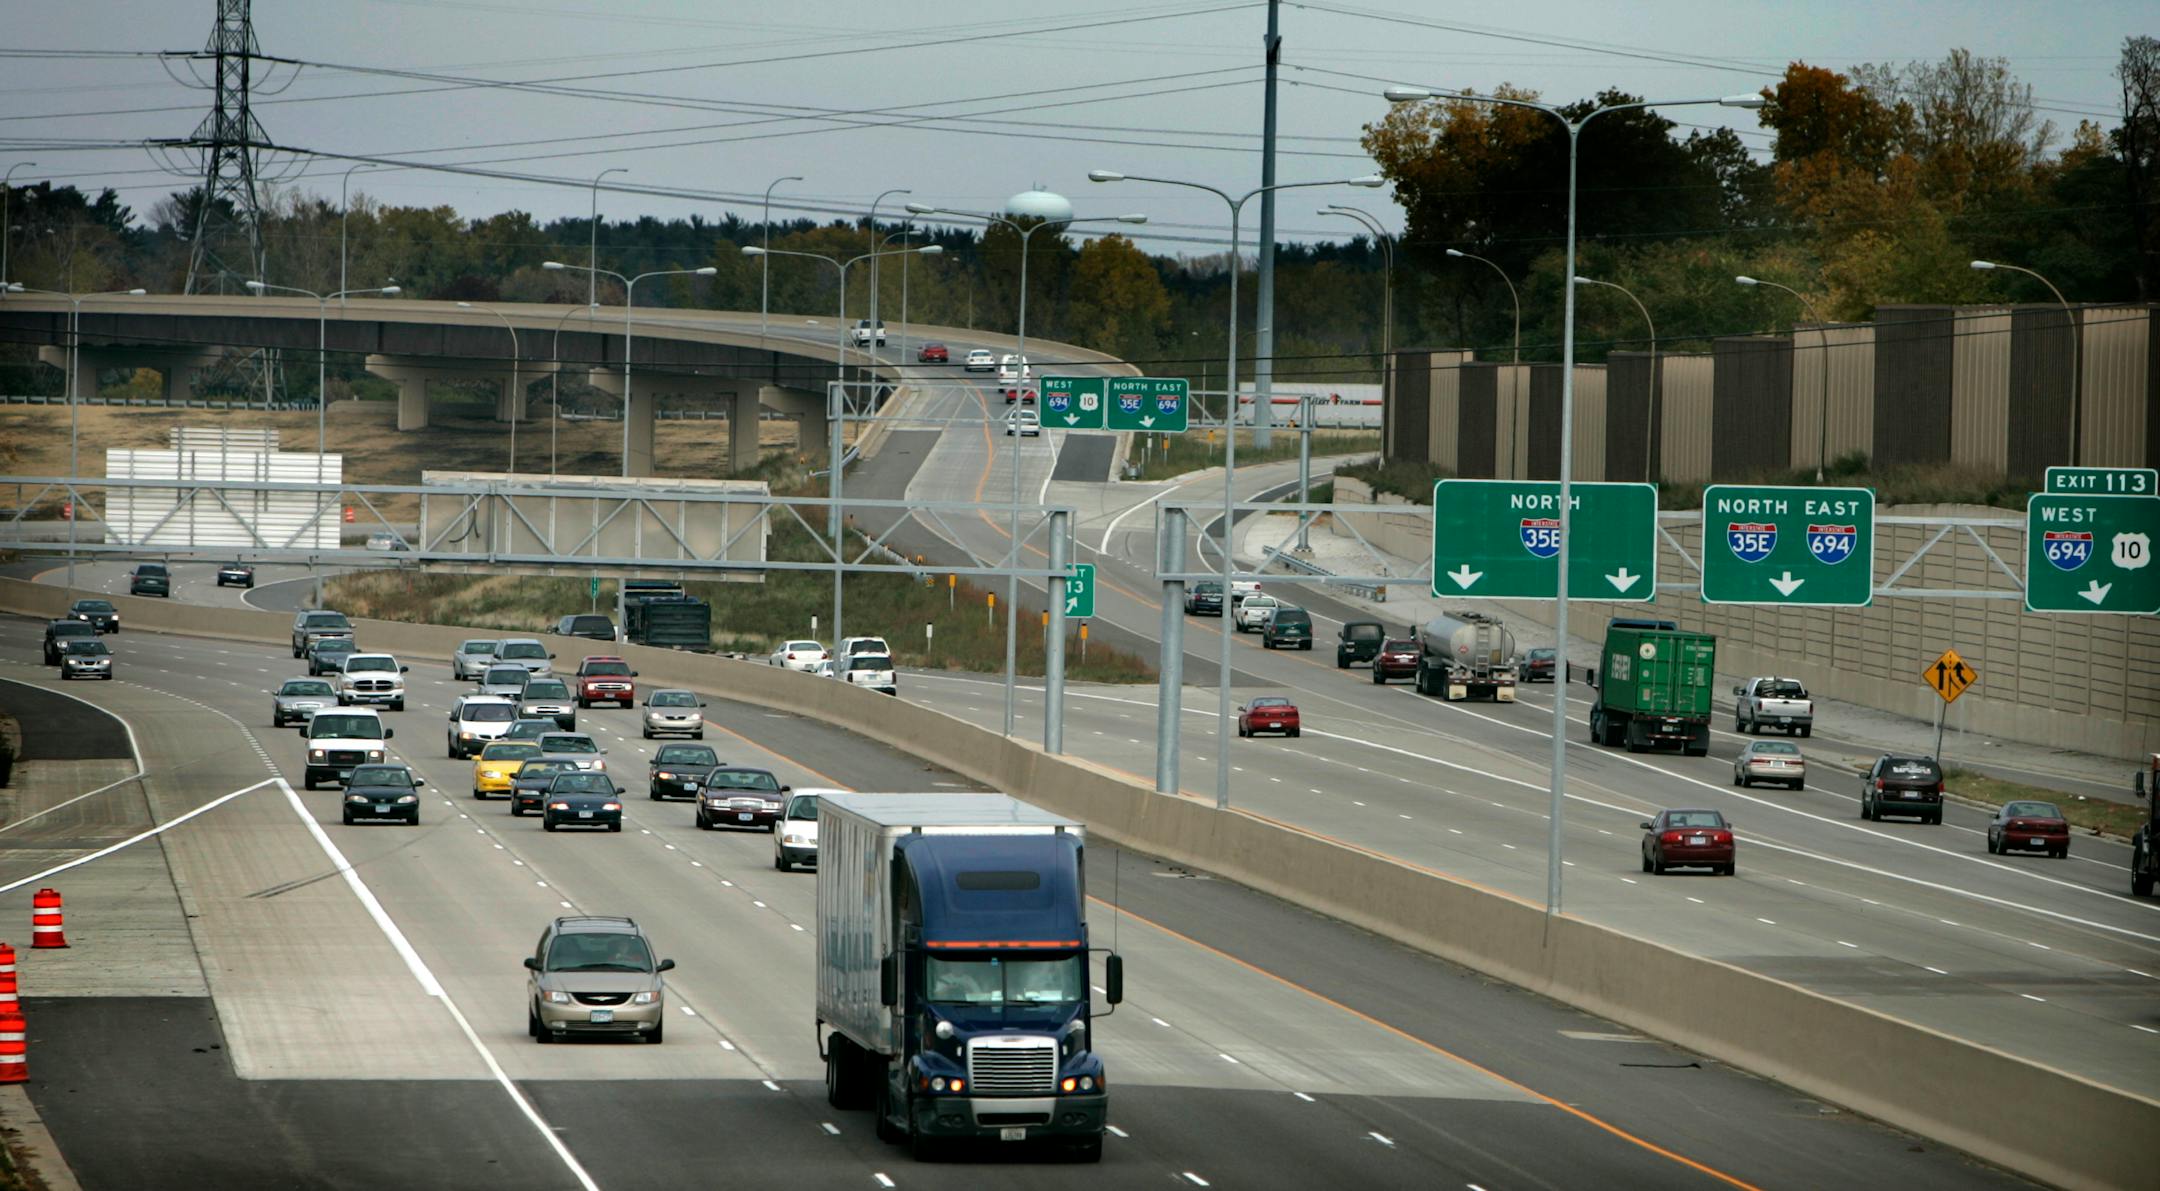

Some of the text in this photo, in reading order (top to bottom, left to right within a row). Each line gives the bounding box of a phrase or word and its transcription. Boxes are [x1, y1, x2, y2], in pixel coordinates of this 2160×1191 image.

[1045, 380, 1073, 389] WEST
[1113, 382, 1182, 392] NORTH EAST
[1049, 397, 1068, 407] 694
[1083, 397, 1094, 406] 10
[1120, 399, 1139, 409] 35E
[1158, 400, 1177, 410] 694
[2056, 473, 2146, 492] EXIT 113
[1511, 494, 1580, 510] NORTH
[1718, 498, 1859, 516] NORTH EAST
[2041, 506, 2097, 523] WEST
[1525, 529, 1560, 548] 35E
[1732, 533, 1770, 552] 35E
[1811, 535, 1850, 554] 694
[2048, 541, 2087, 561] 694
[2120, 541, 2141, 559] 10
[1066, 580, 1084, 594] 13
